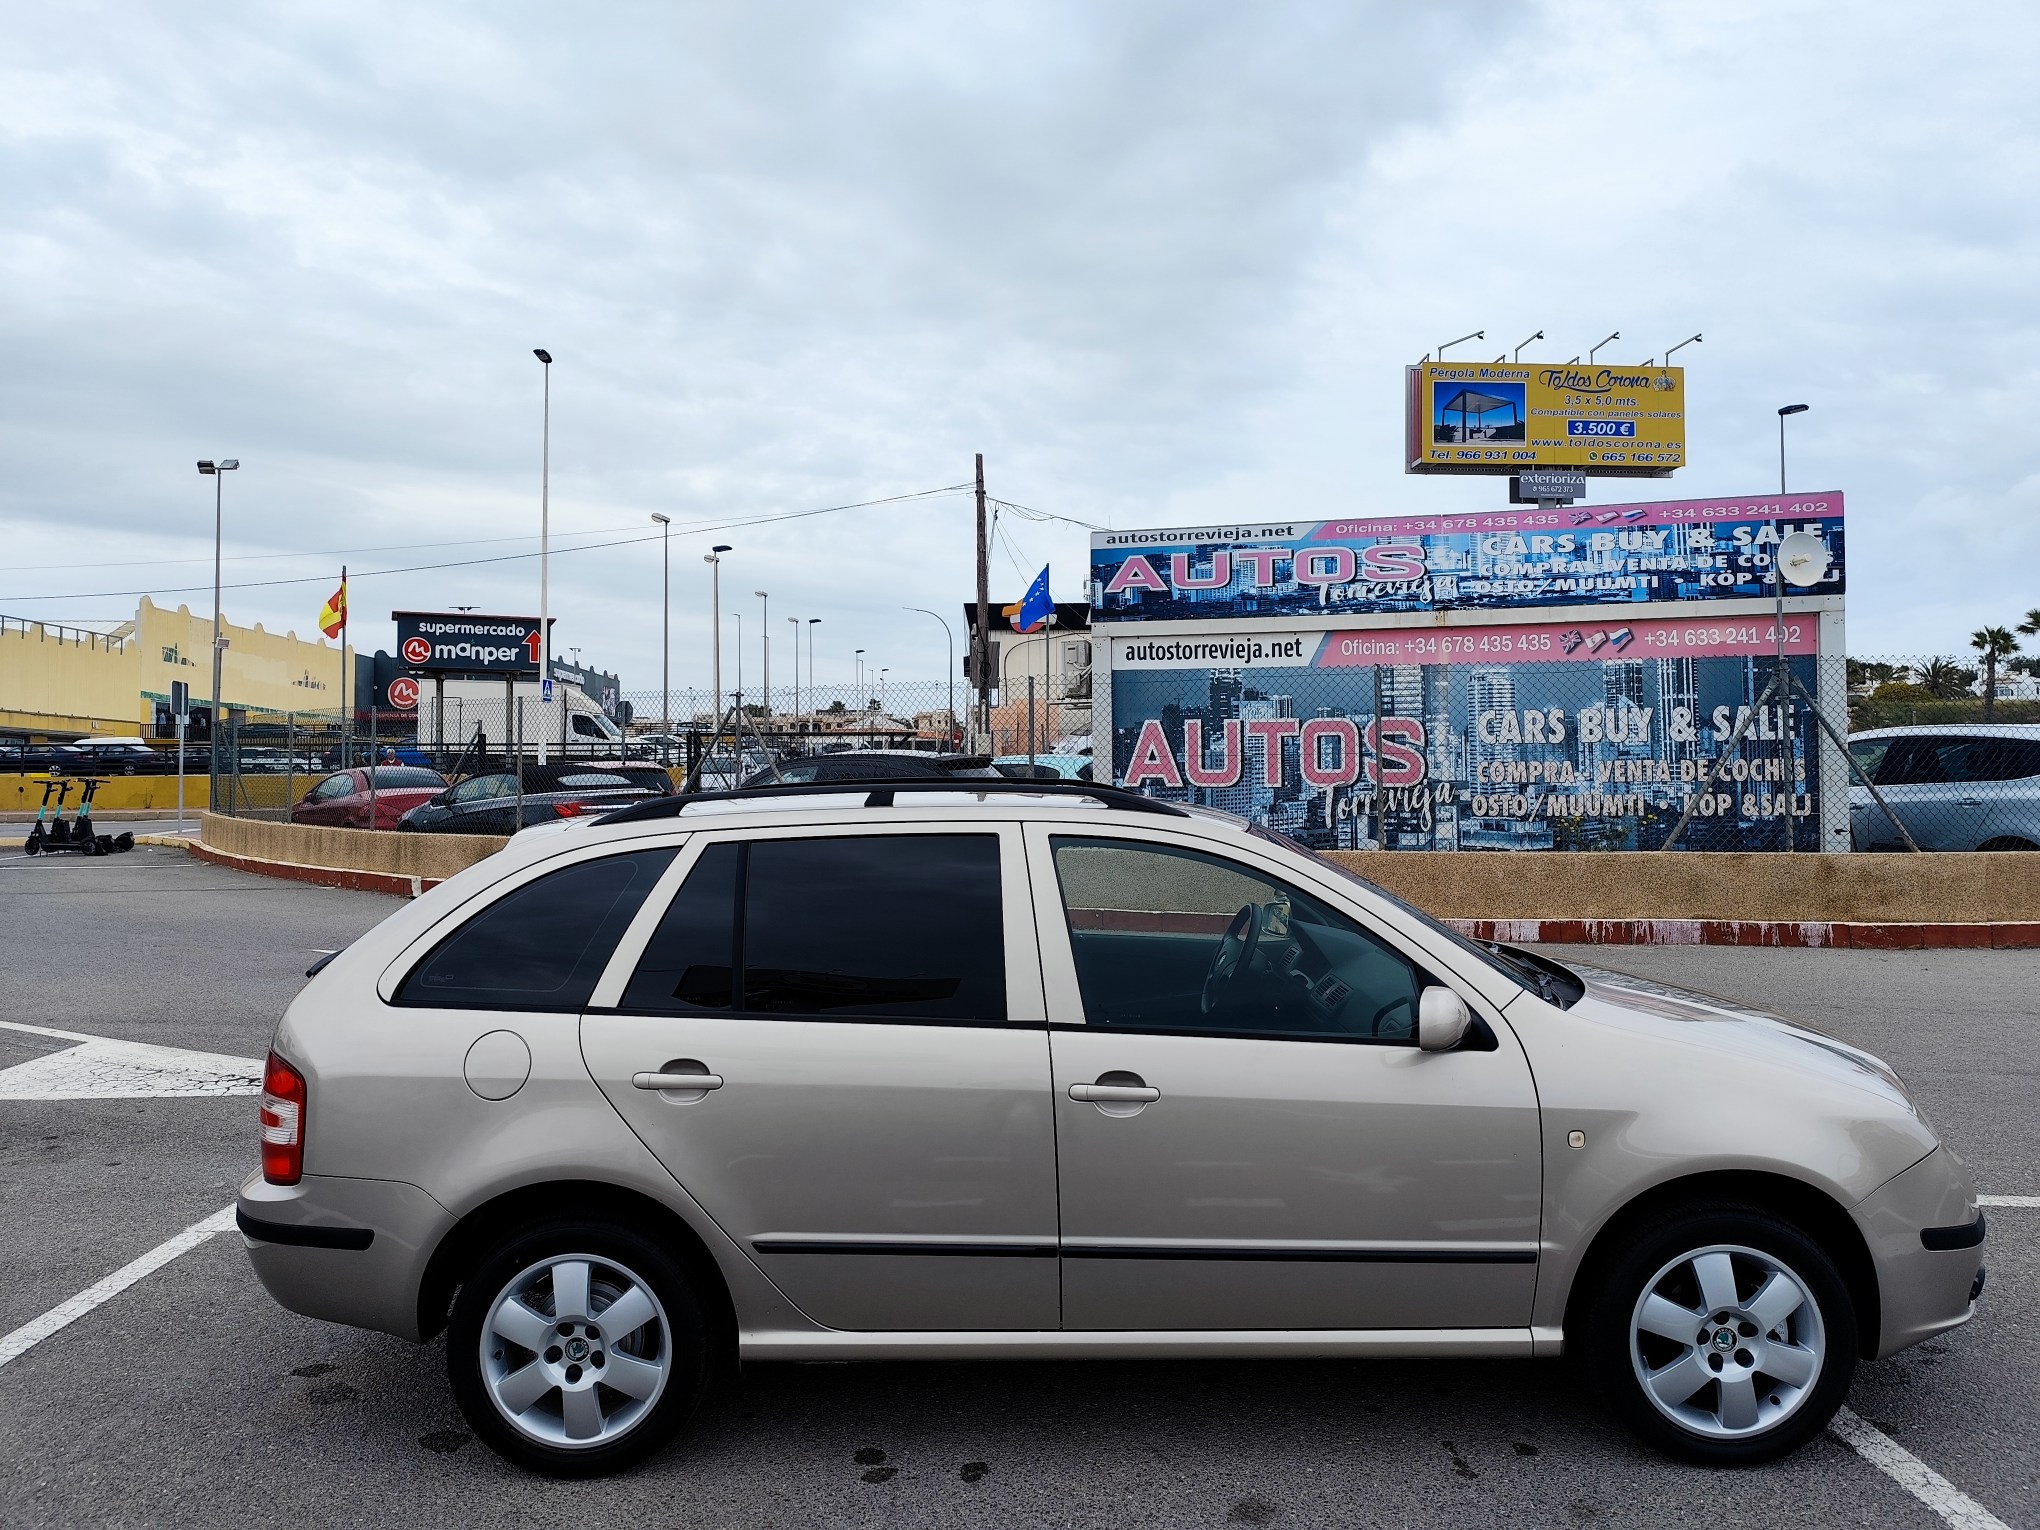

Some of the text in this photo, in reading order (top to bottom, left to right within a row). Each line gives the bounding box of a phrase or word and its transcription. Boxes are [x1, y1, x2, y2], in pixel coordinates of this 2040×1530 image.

[1429, 367, 1531, 380] Pérgola Moderna
[1538, 369, 1651, 393] Toldos Corona
[1564, 395, 1640, 407] 3,5 x 5,0 mts.
[1530, 407, 1585, 417] Compatible
[1607, 410, 1644, 418] paneles
[1647, 410, 1681, 418] solares
[1573, 422, 1631, 435] 3.500 €
[1531, 438, 1681, 449] www.toldoscorona.es
[1430, 450, 1537, 460] Tel. 966 931 004
[1601, 452, 1681, 463] 665 166 572
[1520, 473, 1585, 484] exterioriza
[1550, 485, 1562, 493] 672
[1659, 501, 1829, 519] +34 633 241 402
[1335, 514, 1559, 535] Oficina: +34 678 435 435
[1106, 525, 1294, 545] autostorrevieja.net
[1482, 533, 1575, 556] CARS
[1591, 529, 1671, 552] BUY
[1686, 528, 1717, 548] &
[1103, 544, 1428, 593] AUTOS
[1480, 560, 1585, 577] COMPRA
[1611, 555, 1688, 571] VENTA
[1702, 554, 1727, 569] DE
[1700, 570, 1753, 587] KÖP
[1318, 574, 1458, 606] Torrevieja
[418, 622, 525, 637] supermercado
[1644, 630, 1679, 647] +34
[1684, 628, 1720, 645] 633
[1725, 627, 1761, 644] 241
[435, 642, 520, 665] manper
[1125, 637, 1302, 664] autostorrevieja.net
[1340, 633, 1551, 655] Oficina: +34 678 435 435
[1478, 705, 1795, 744] CARS BUY & SALE
[1122, 717, 1428, 788] AUTOS
[1476, 760, 1576, 783] COMPRA
[1600, 759, 1671, 782] VENTA
[1680, 759, 1709, 782] DE
[1321, 778, 1455, 832] Torrevieja
